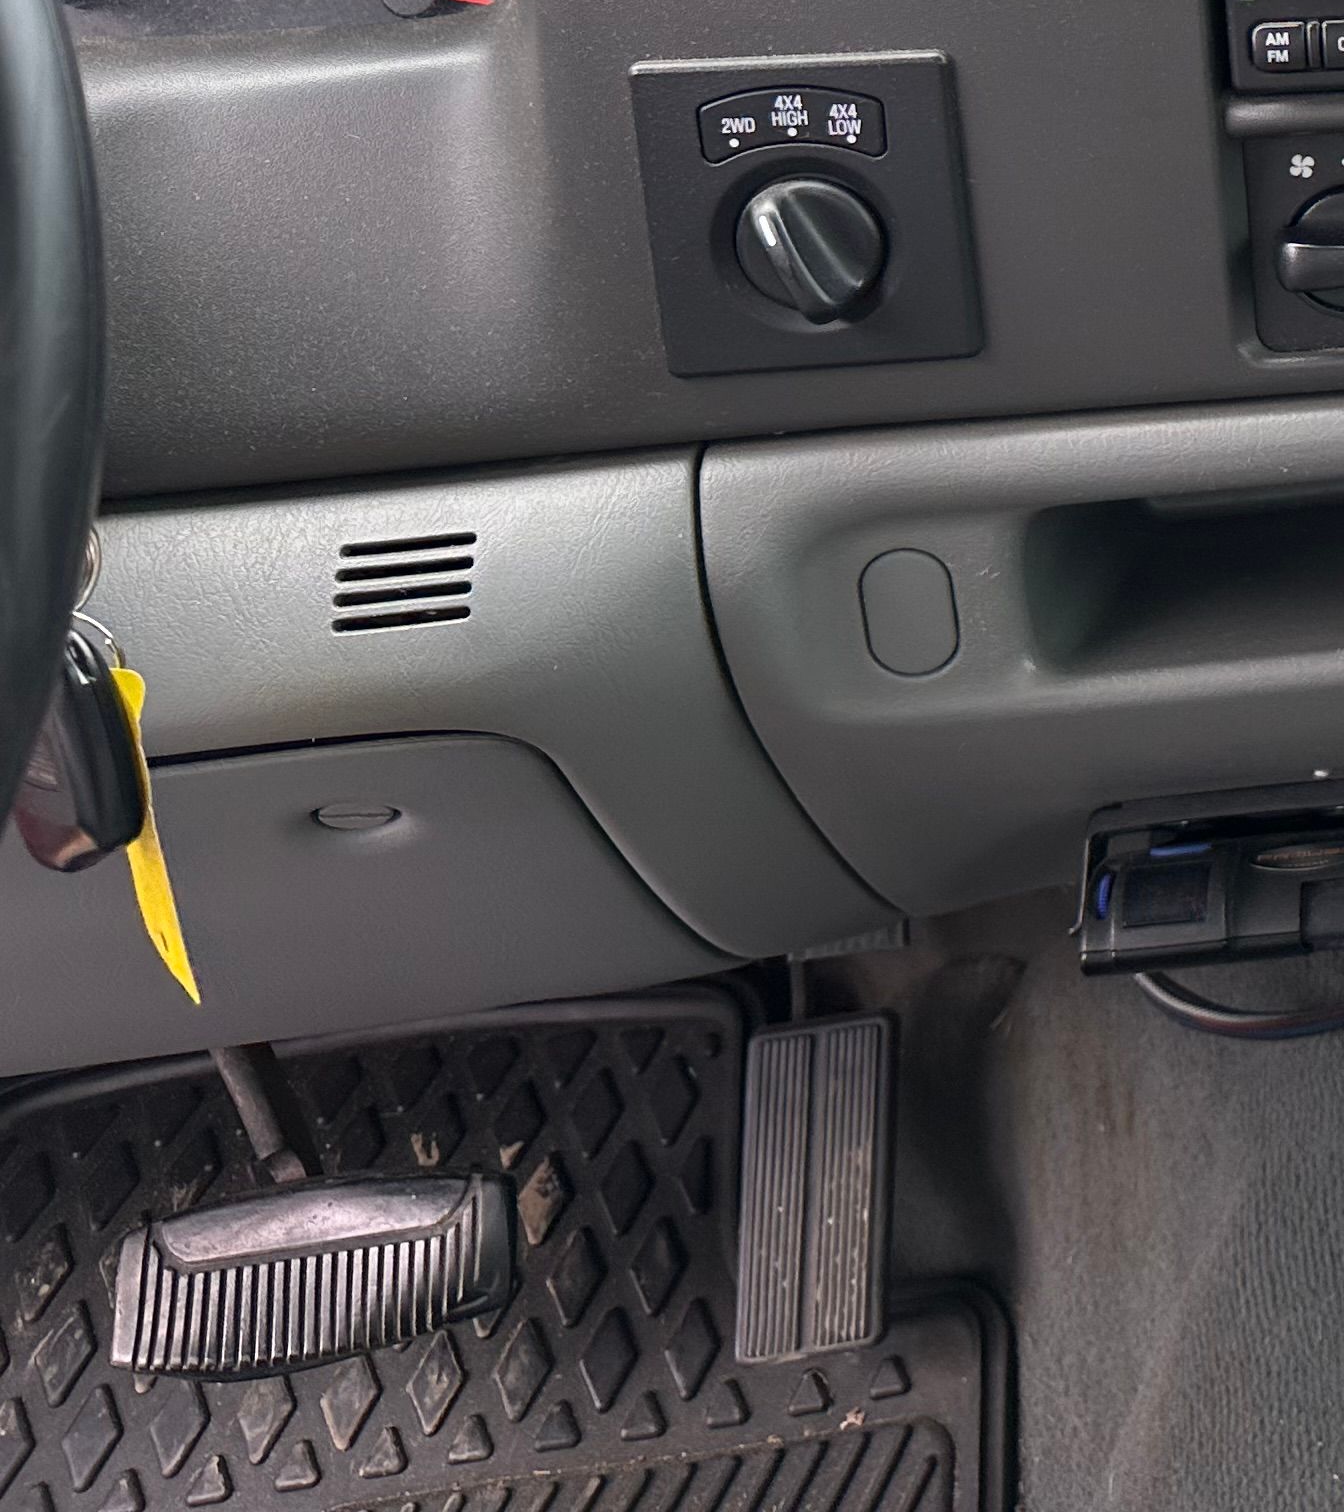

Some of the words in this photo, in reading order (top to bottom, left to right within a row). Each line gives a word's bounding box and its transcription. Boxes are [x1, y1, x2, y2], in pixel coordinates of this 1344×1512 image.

[1265, 33, 1289, 46] AM
[1267, 49, 1289, 63] FM
[774, 95, 803, 110] 4X4
[772, 110, 808, 126] HIGH
[829, 104, 858, 119] 4X4
[721, 117, 755, 134] 2WD
[828, 119, 861, 136] LOW
